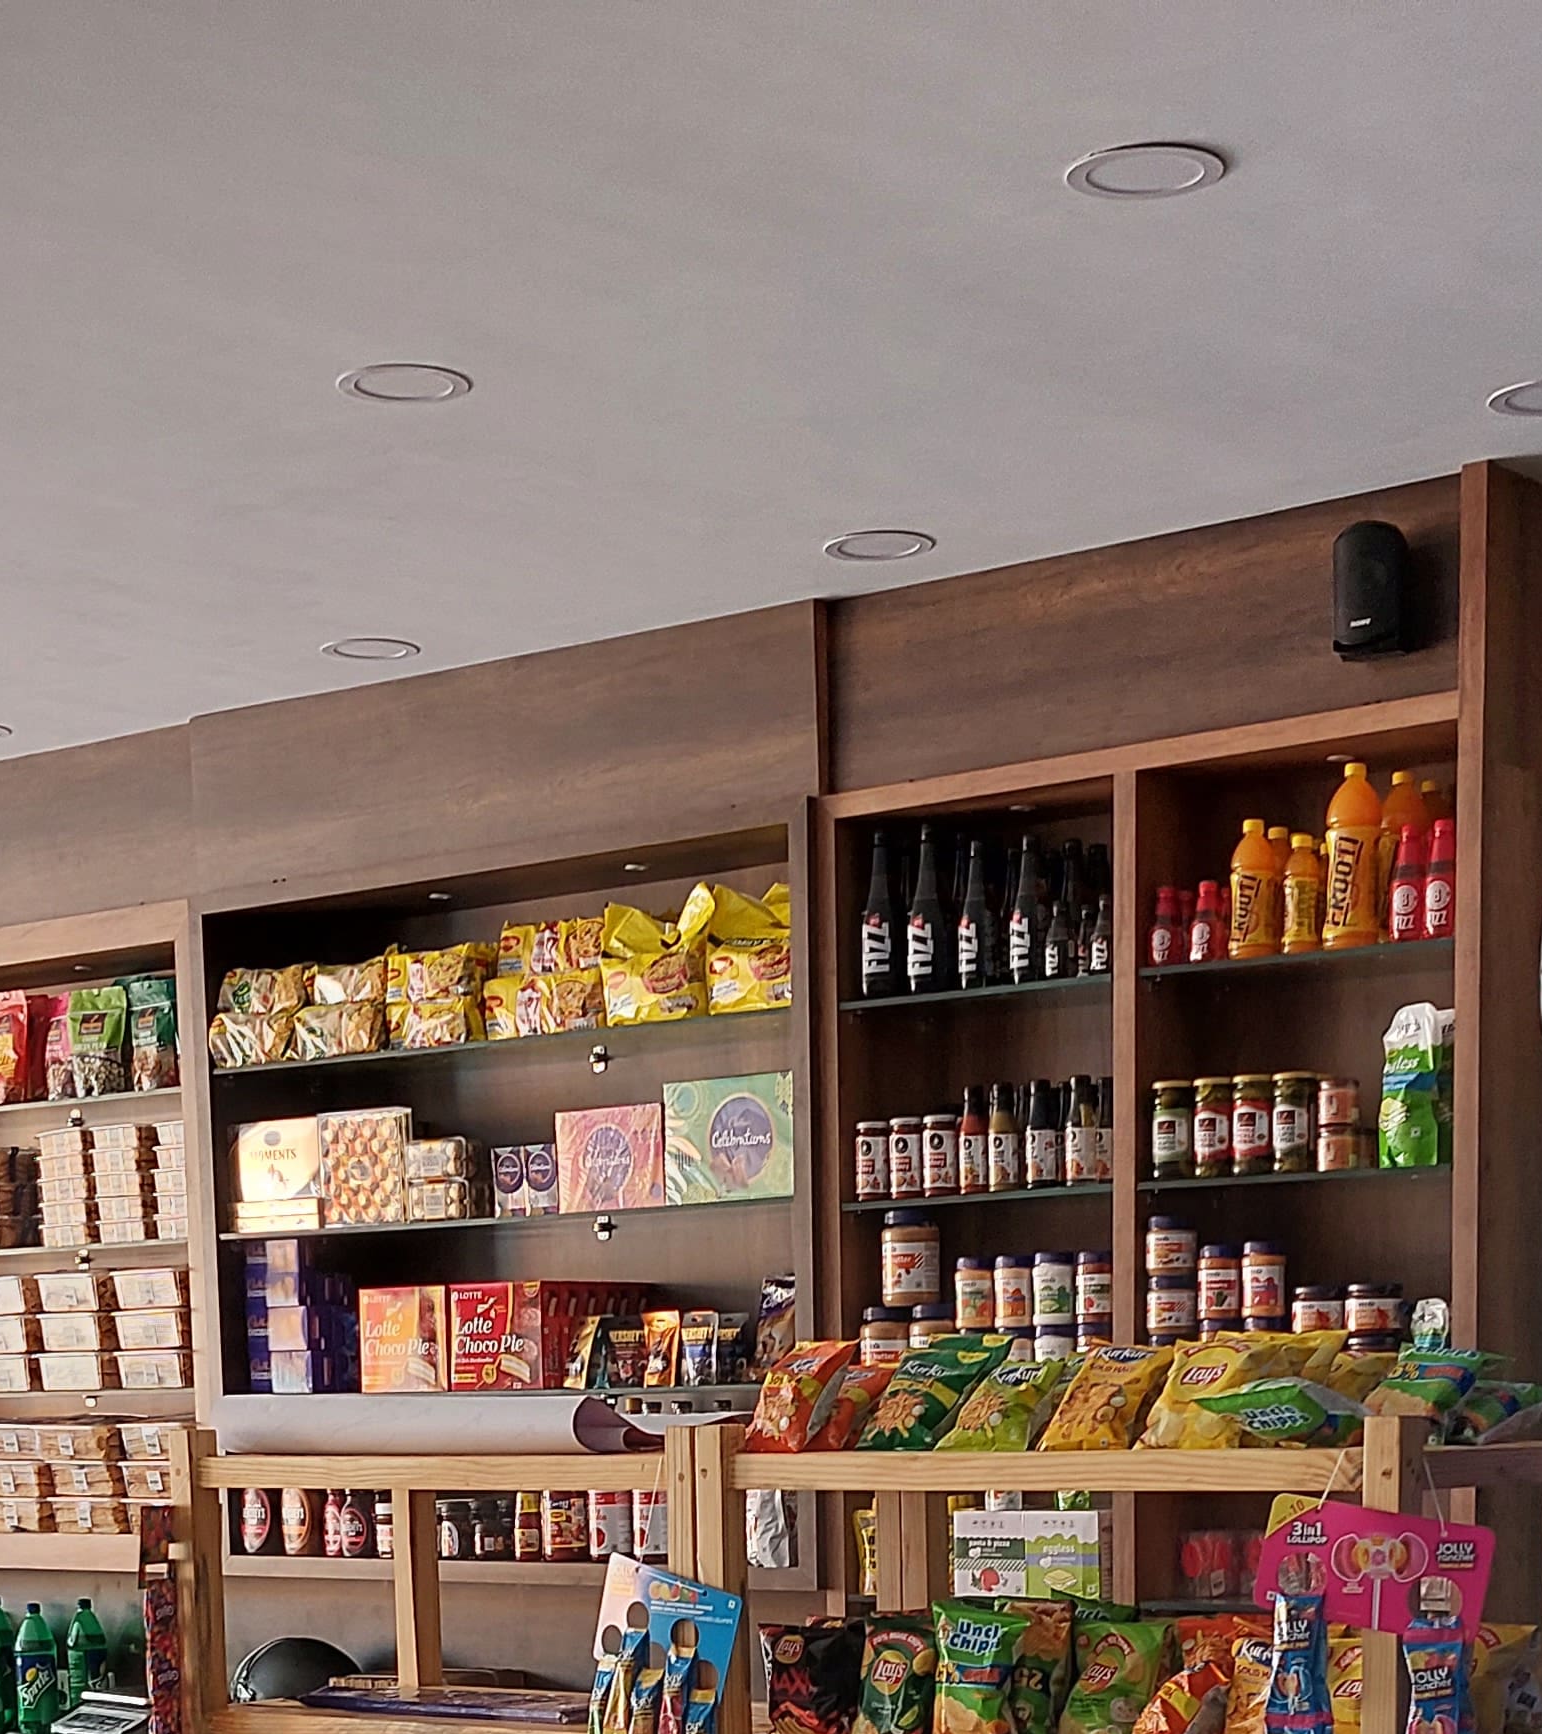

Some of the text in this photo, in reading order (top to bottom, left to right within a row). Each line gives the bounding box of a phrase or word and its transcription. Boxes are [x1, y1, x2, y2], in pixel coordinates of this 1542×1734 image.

[862, 921, 891, 975] FIZZ
[908, 922, 933, 976] FIZZ
[959, 922, 978, 973] FIZZ
[1010, 917, 1030, 969] FIZZ
[712, 1129, 772, 1148] Celebrations
[459, 1291, 482, 1299] LOTTE
[365, 1320, 401, 1338] Lotte
[455, 1316, 493, 1335] Lotte
[365, 1337, 430, 1357] Choco Pie
[455, 1334, 525, 1355] Choco Pie
[991, 1364, 1046, 1385] Kurkur
[1182, 1362, 1228, 1385] Lay's
[1242, 1403, 1288, 1421] Uncle
[1245, 1411, 1312, 1432] Chipps
[1290, 1499, 1306, 1514] 10
[1287, 1534, 1328, 1545] LOLLIPOP
[1436, 1541, 1475, 1556] JOLLY
[1437, 1553, 1476, 1563] rancher
[959, 1619, 1002, 1640] Uncl
[872, 1657, 907, 1685] Lay's
[20, 1669, 53, 1707] Sprite
